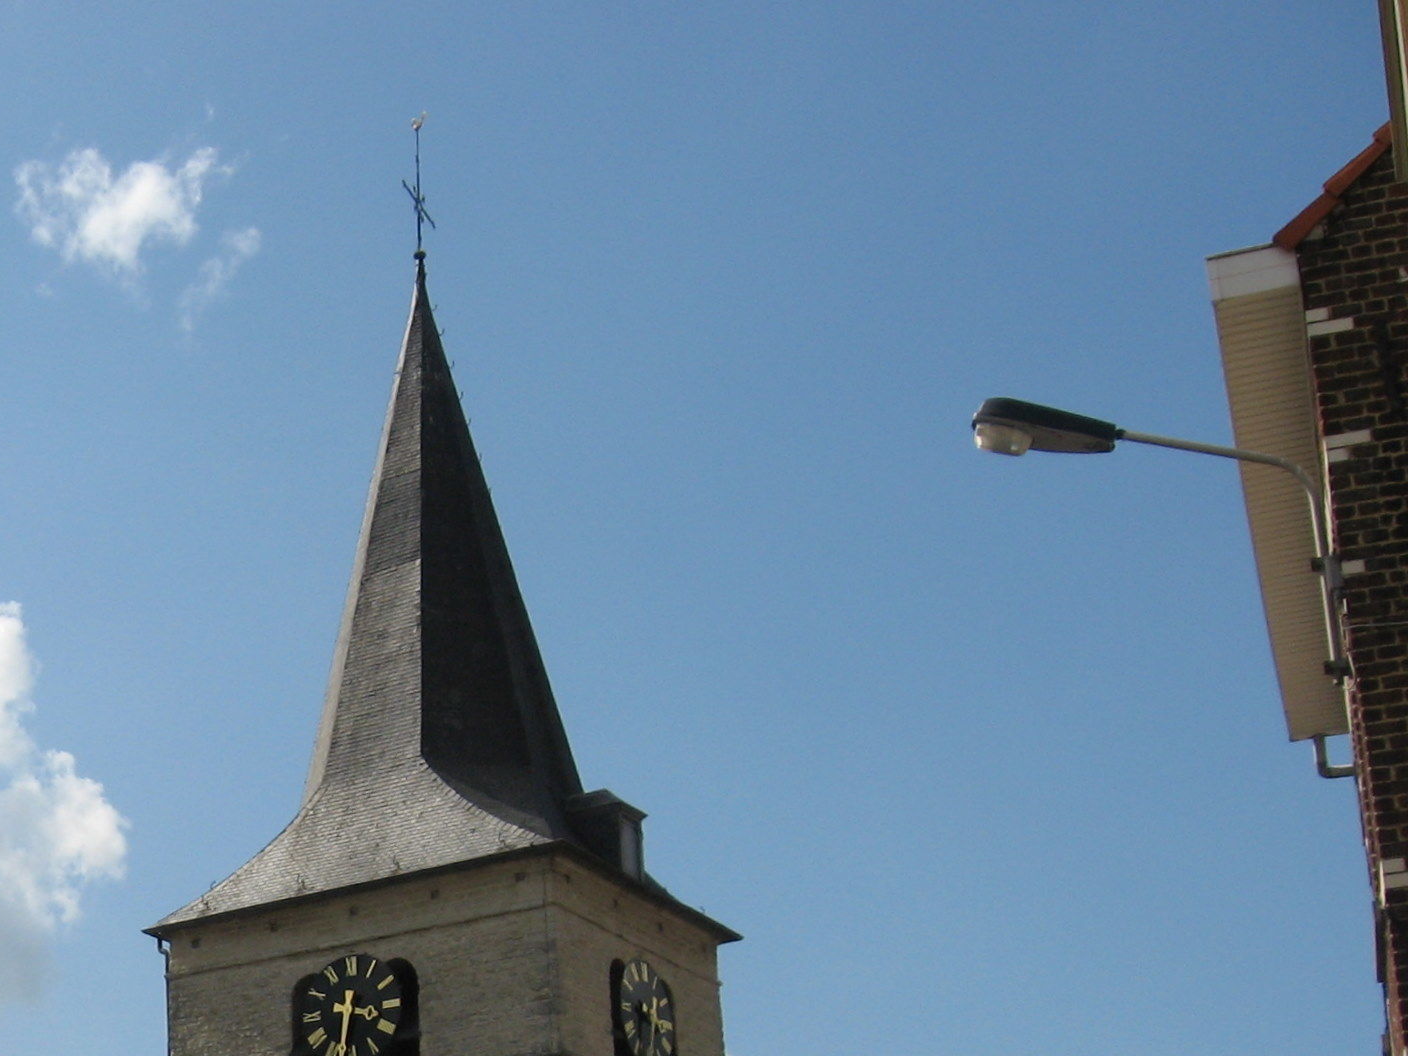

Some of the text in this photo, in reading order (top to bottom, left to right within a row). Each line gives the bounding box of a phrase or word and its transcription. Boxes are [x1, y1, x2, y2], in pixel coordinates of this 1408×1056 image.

[366, 959, 377, 978] I
[307, 988, 327, 1001] X
[302, 1010, 322, 1023] IX
